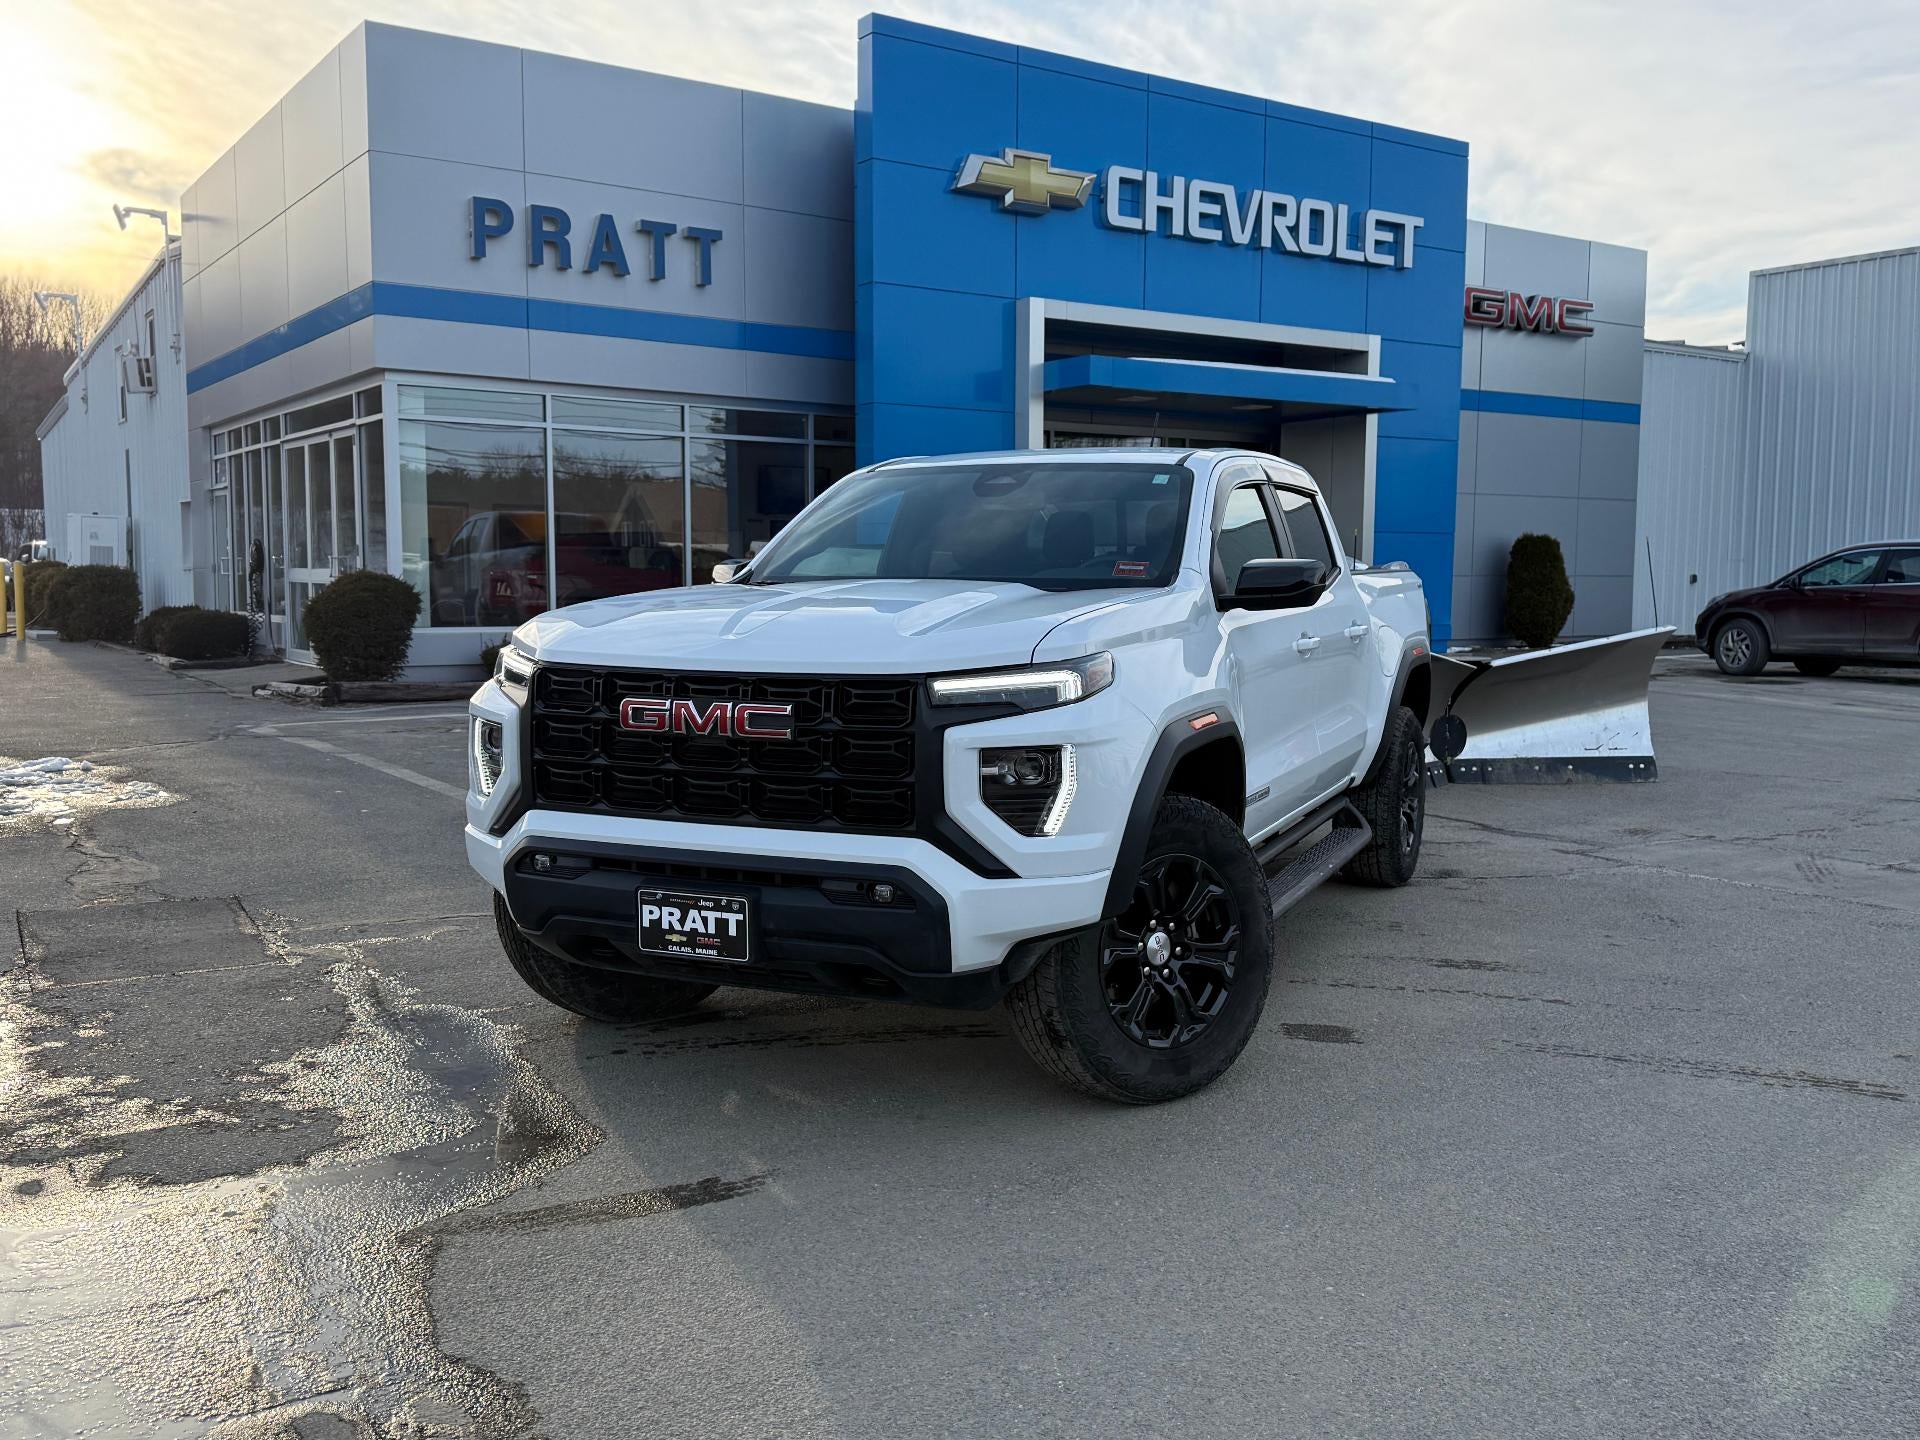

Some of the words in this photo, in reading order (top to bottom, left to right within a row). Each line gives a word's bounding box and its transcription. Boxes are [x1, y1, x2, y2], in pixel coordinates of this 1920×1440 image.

[1103, 165, 1424, 268] CHEVROLET
[470, 196, 723, 287] PRATT
[1464, 286, 1594, 337] GMC
[619, 698, 792, 739] GMC
[642, 904, 744, 936] PRATT
[697, 898, 714, 908] Jeep
[668, 944, 694, 954] CALAIS,
[695, 947, 718, 956] MAINE
[696, 936, 721, 946] GMC
